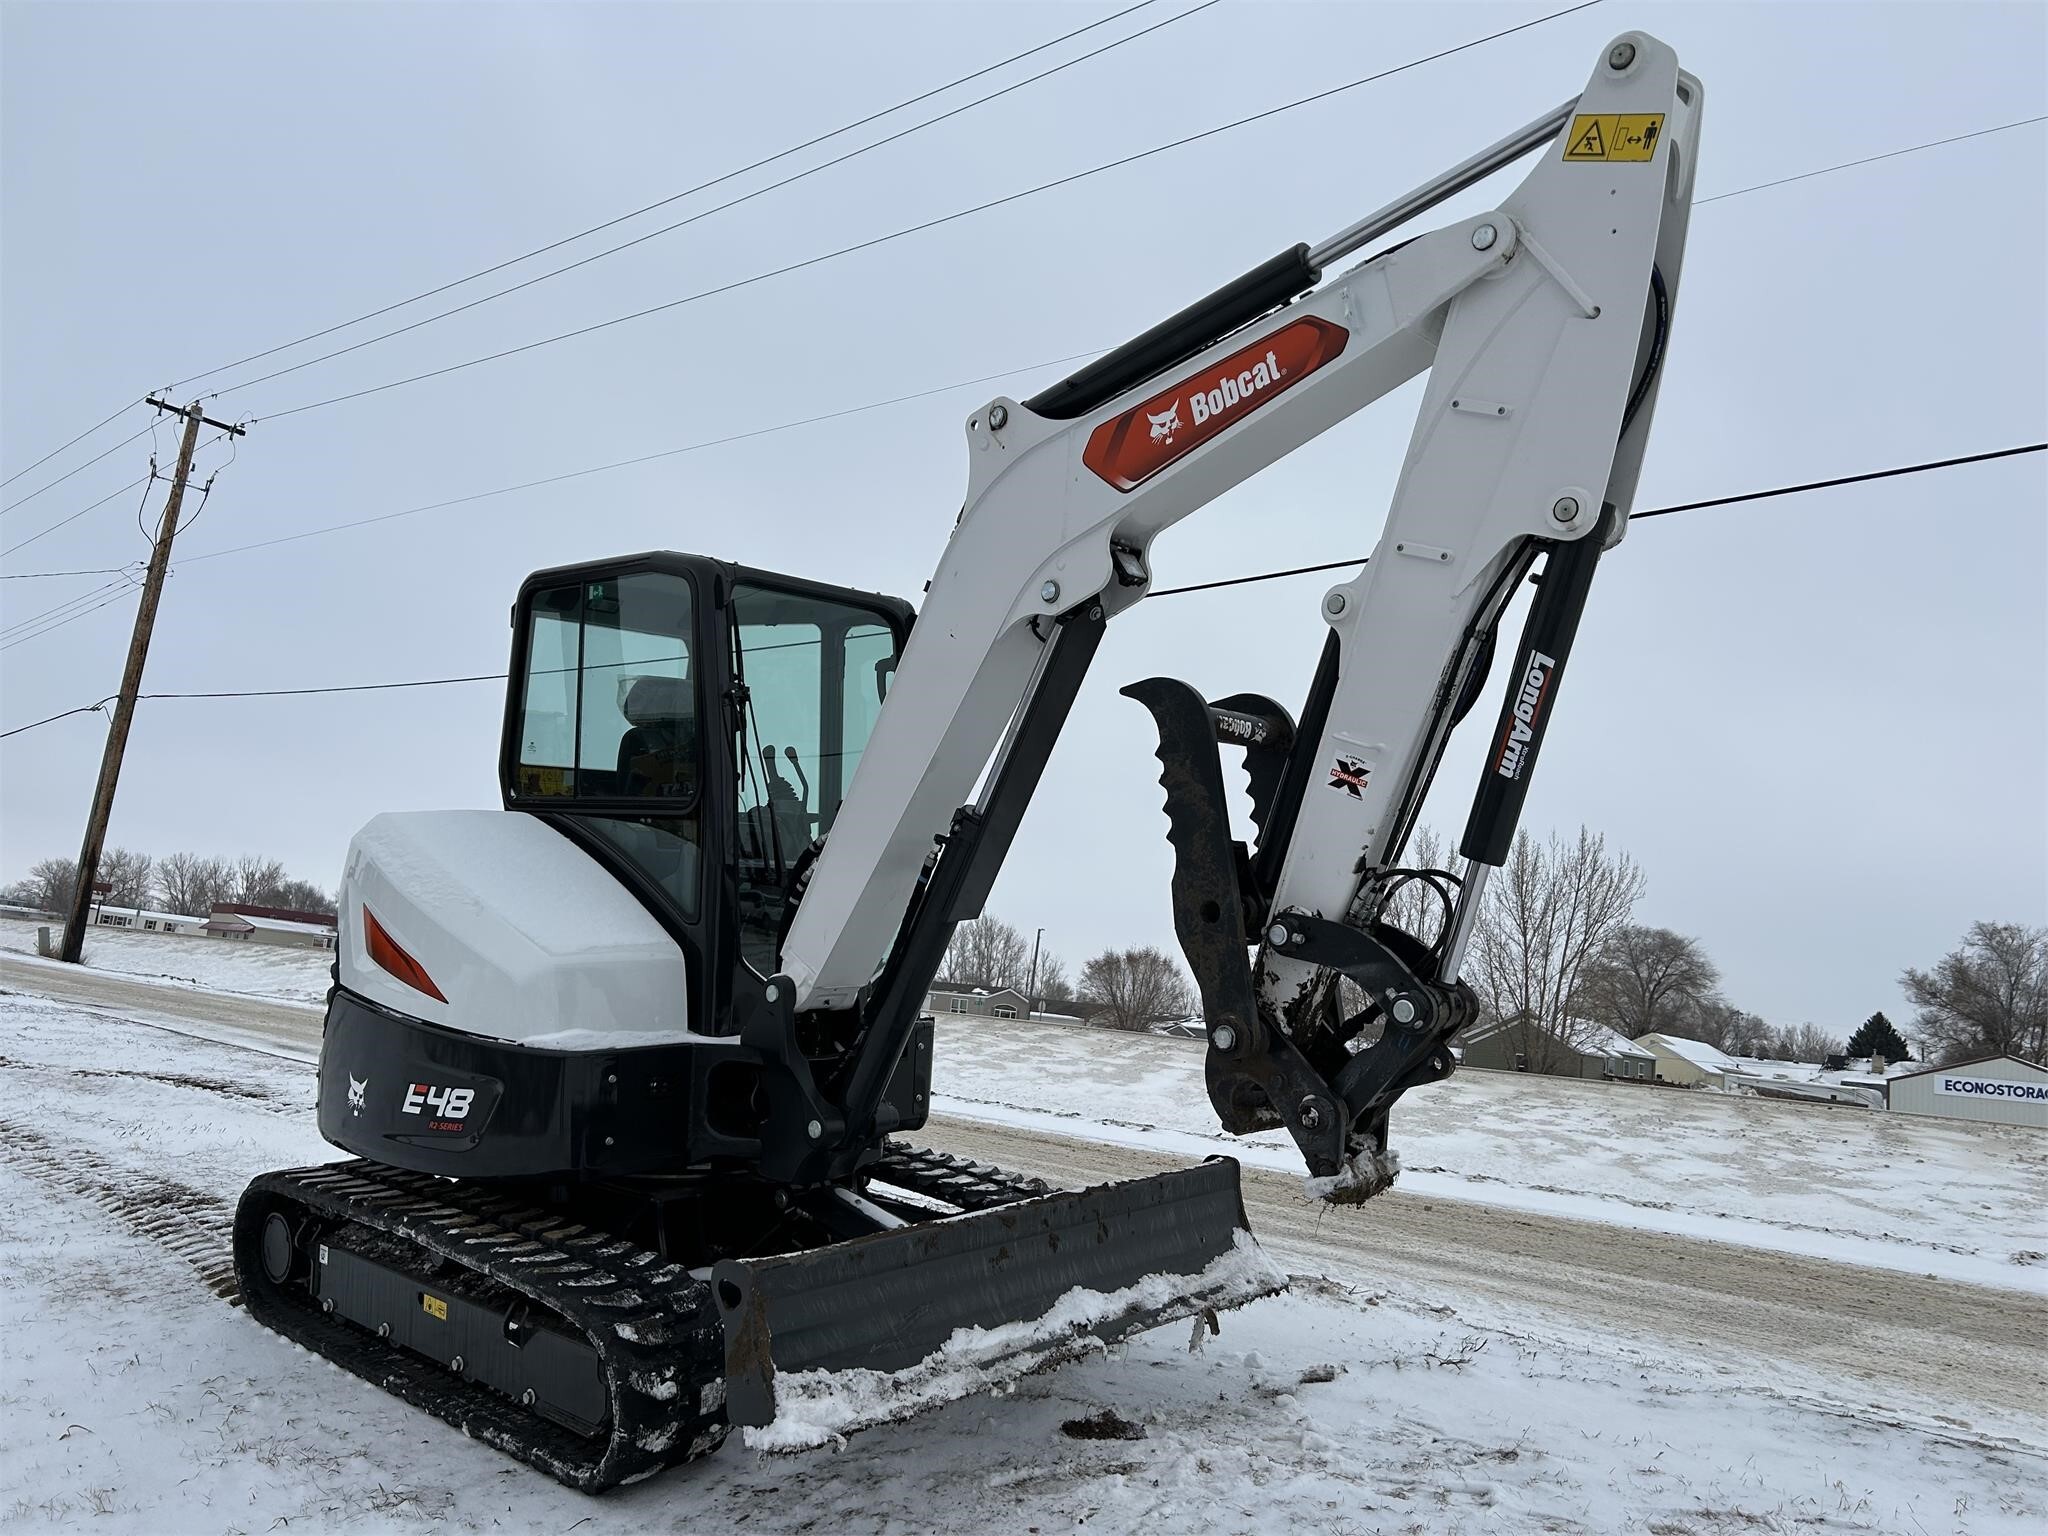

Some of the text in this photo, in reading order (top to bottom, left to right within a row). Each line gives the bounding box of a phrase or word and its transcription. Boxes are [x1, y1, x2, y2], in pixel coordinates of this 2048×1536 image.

[1189, 350, 1281, 426] Bobcat
[1498, 649, 1556, 779] LongArm
[1331, 770, 1367, 787] HYDRAULIC
[401, 1083, 475, 1119] E48
